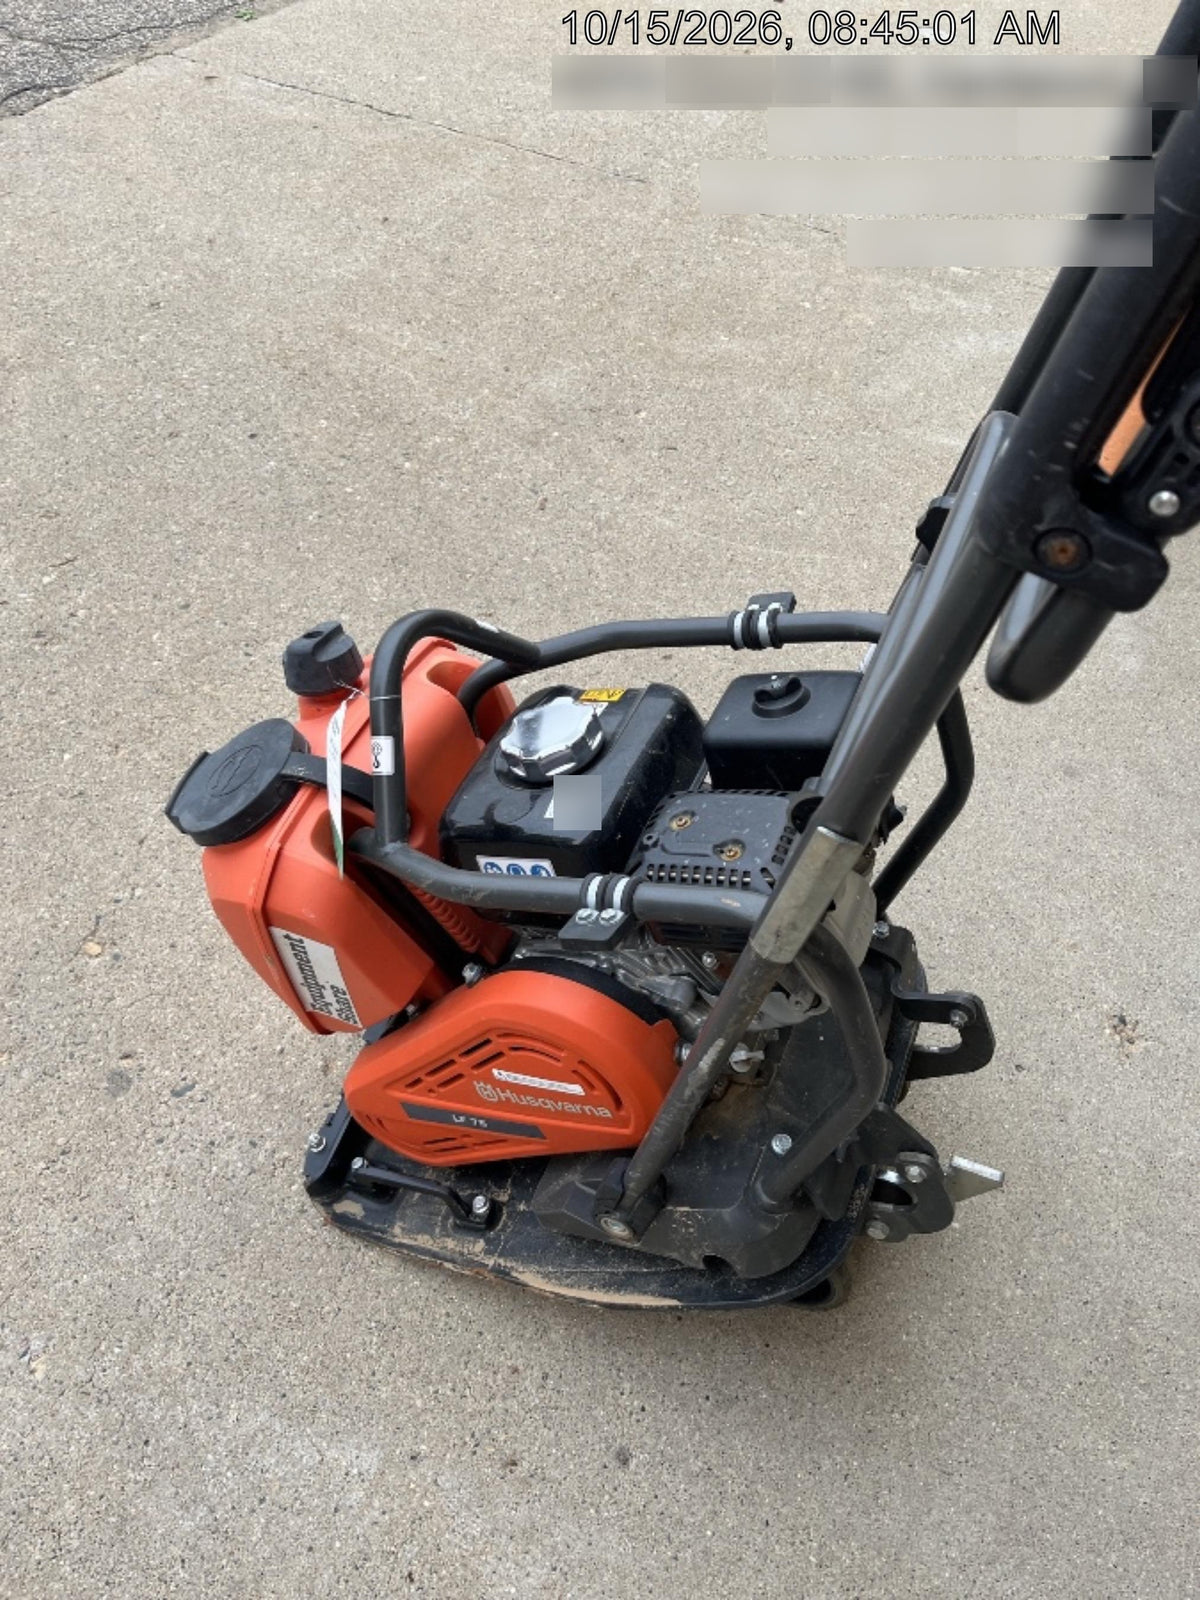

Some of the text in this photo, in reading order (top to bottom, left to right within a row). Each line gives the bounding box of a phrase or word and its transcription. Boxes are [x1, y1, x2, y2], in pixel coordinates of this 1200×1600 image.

[283, 933, 334, 1016] Equipment
[330, 984, 358, 1025] Share
[498, 1089, 613, 1119] Husqvarna
